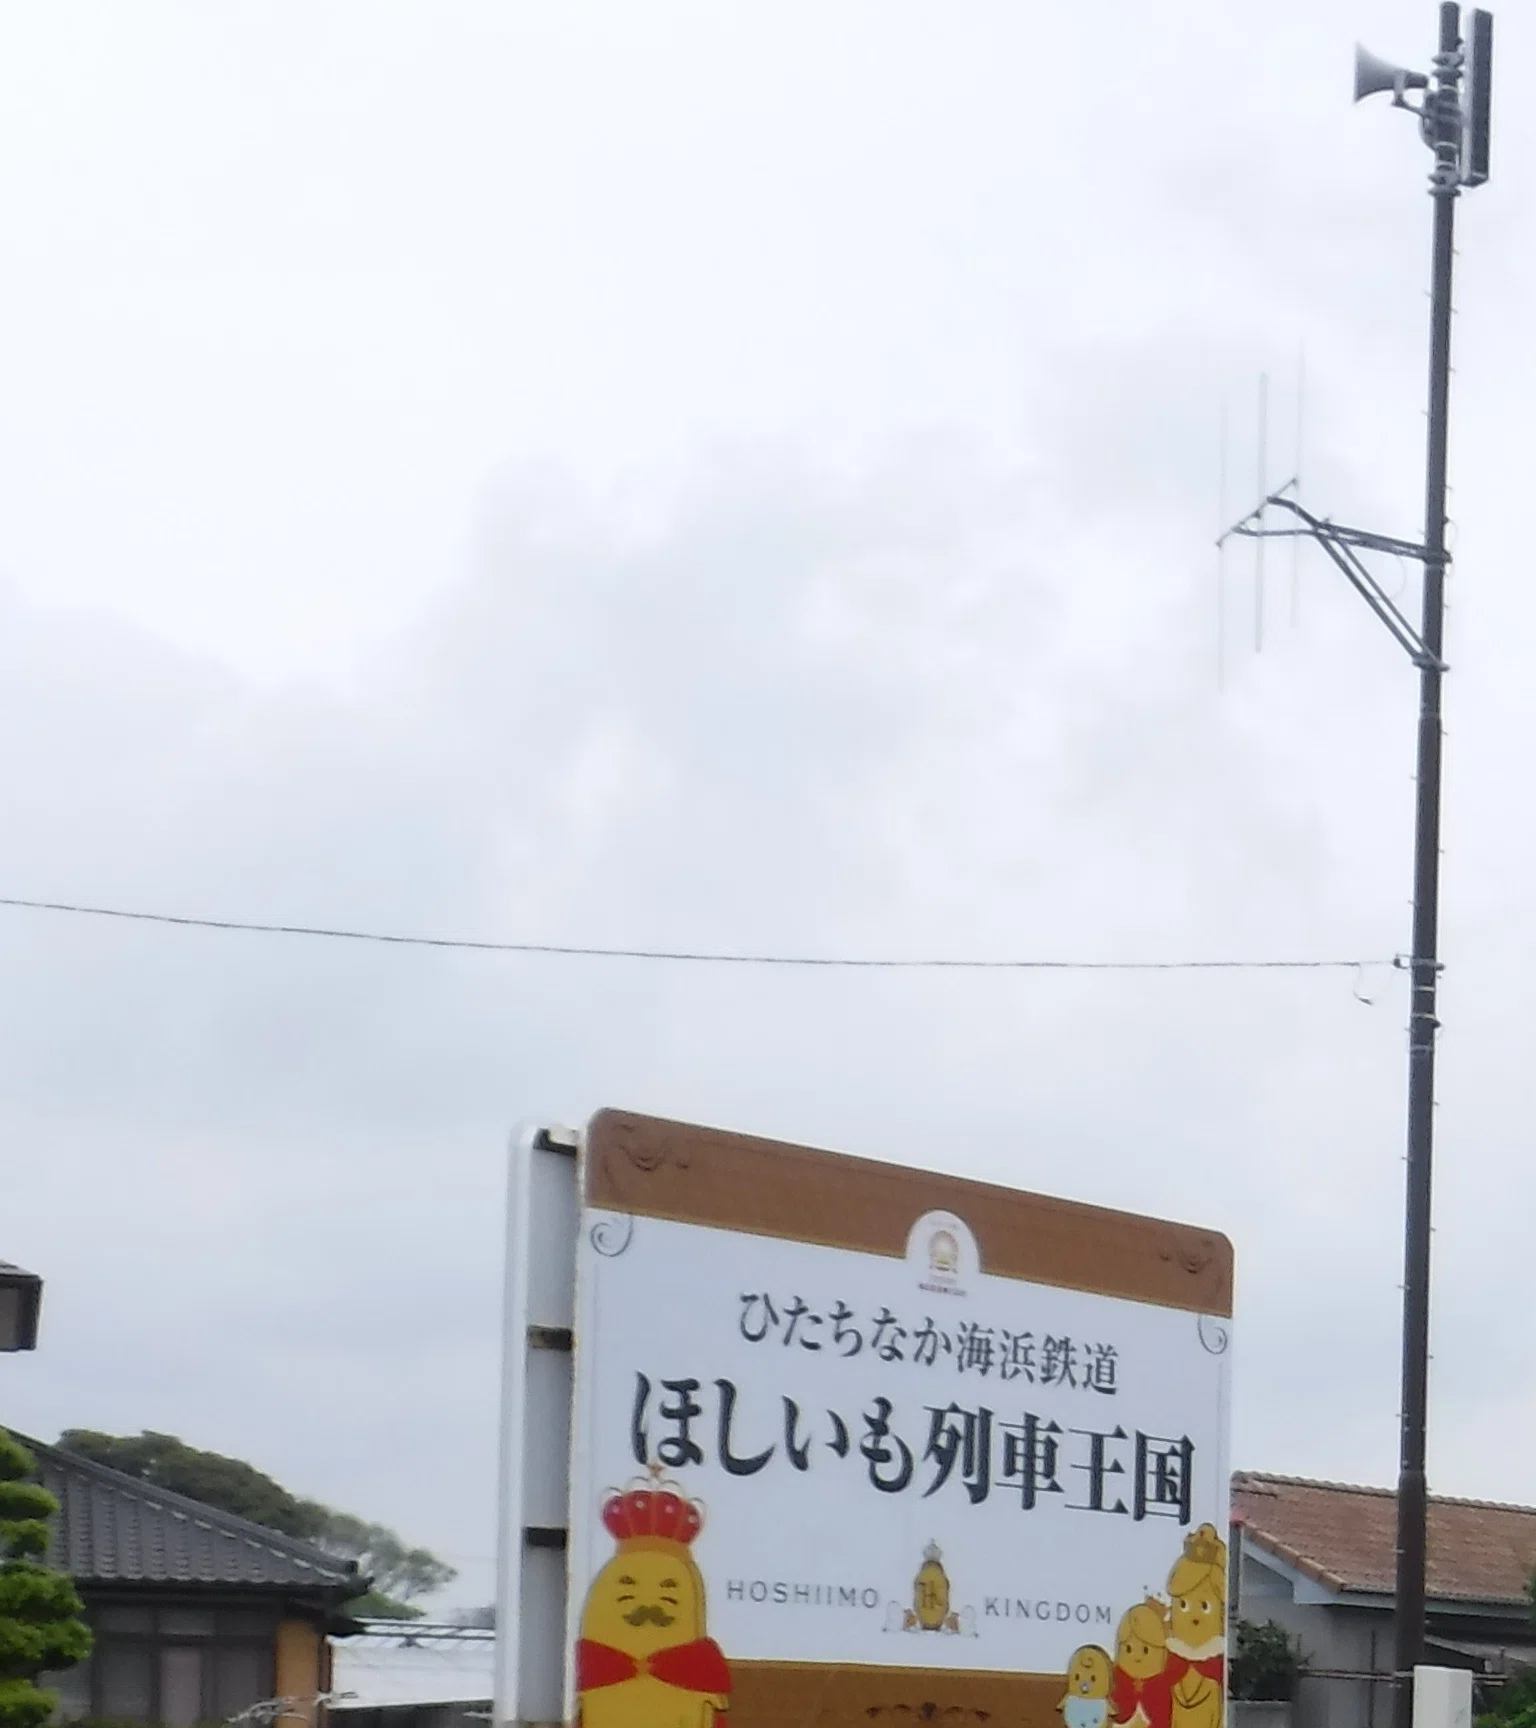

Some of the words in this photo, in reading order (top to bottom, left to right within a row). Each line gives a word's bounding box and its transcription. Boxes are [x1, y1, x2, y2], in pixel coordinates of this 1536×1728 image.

[740, 1292, 1119, 1395] ひたちなか海浜鉄道
[630, 1370, 1196, 1525] ほしいも列車王国
[726, 1580, 879, 1608] HOSHIIMO
[983, 1596, 1112, 1624] KINGDOM
